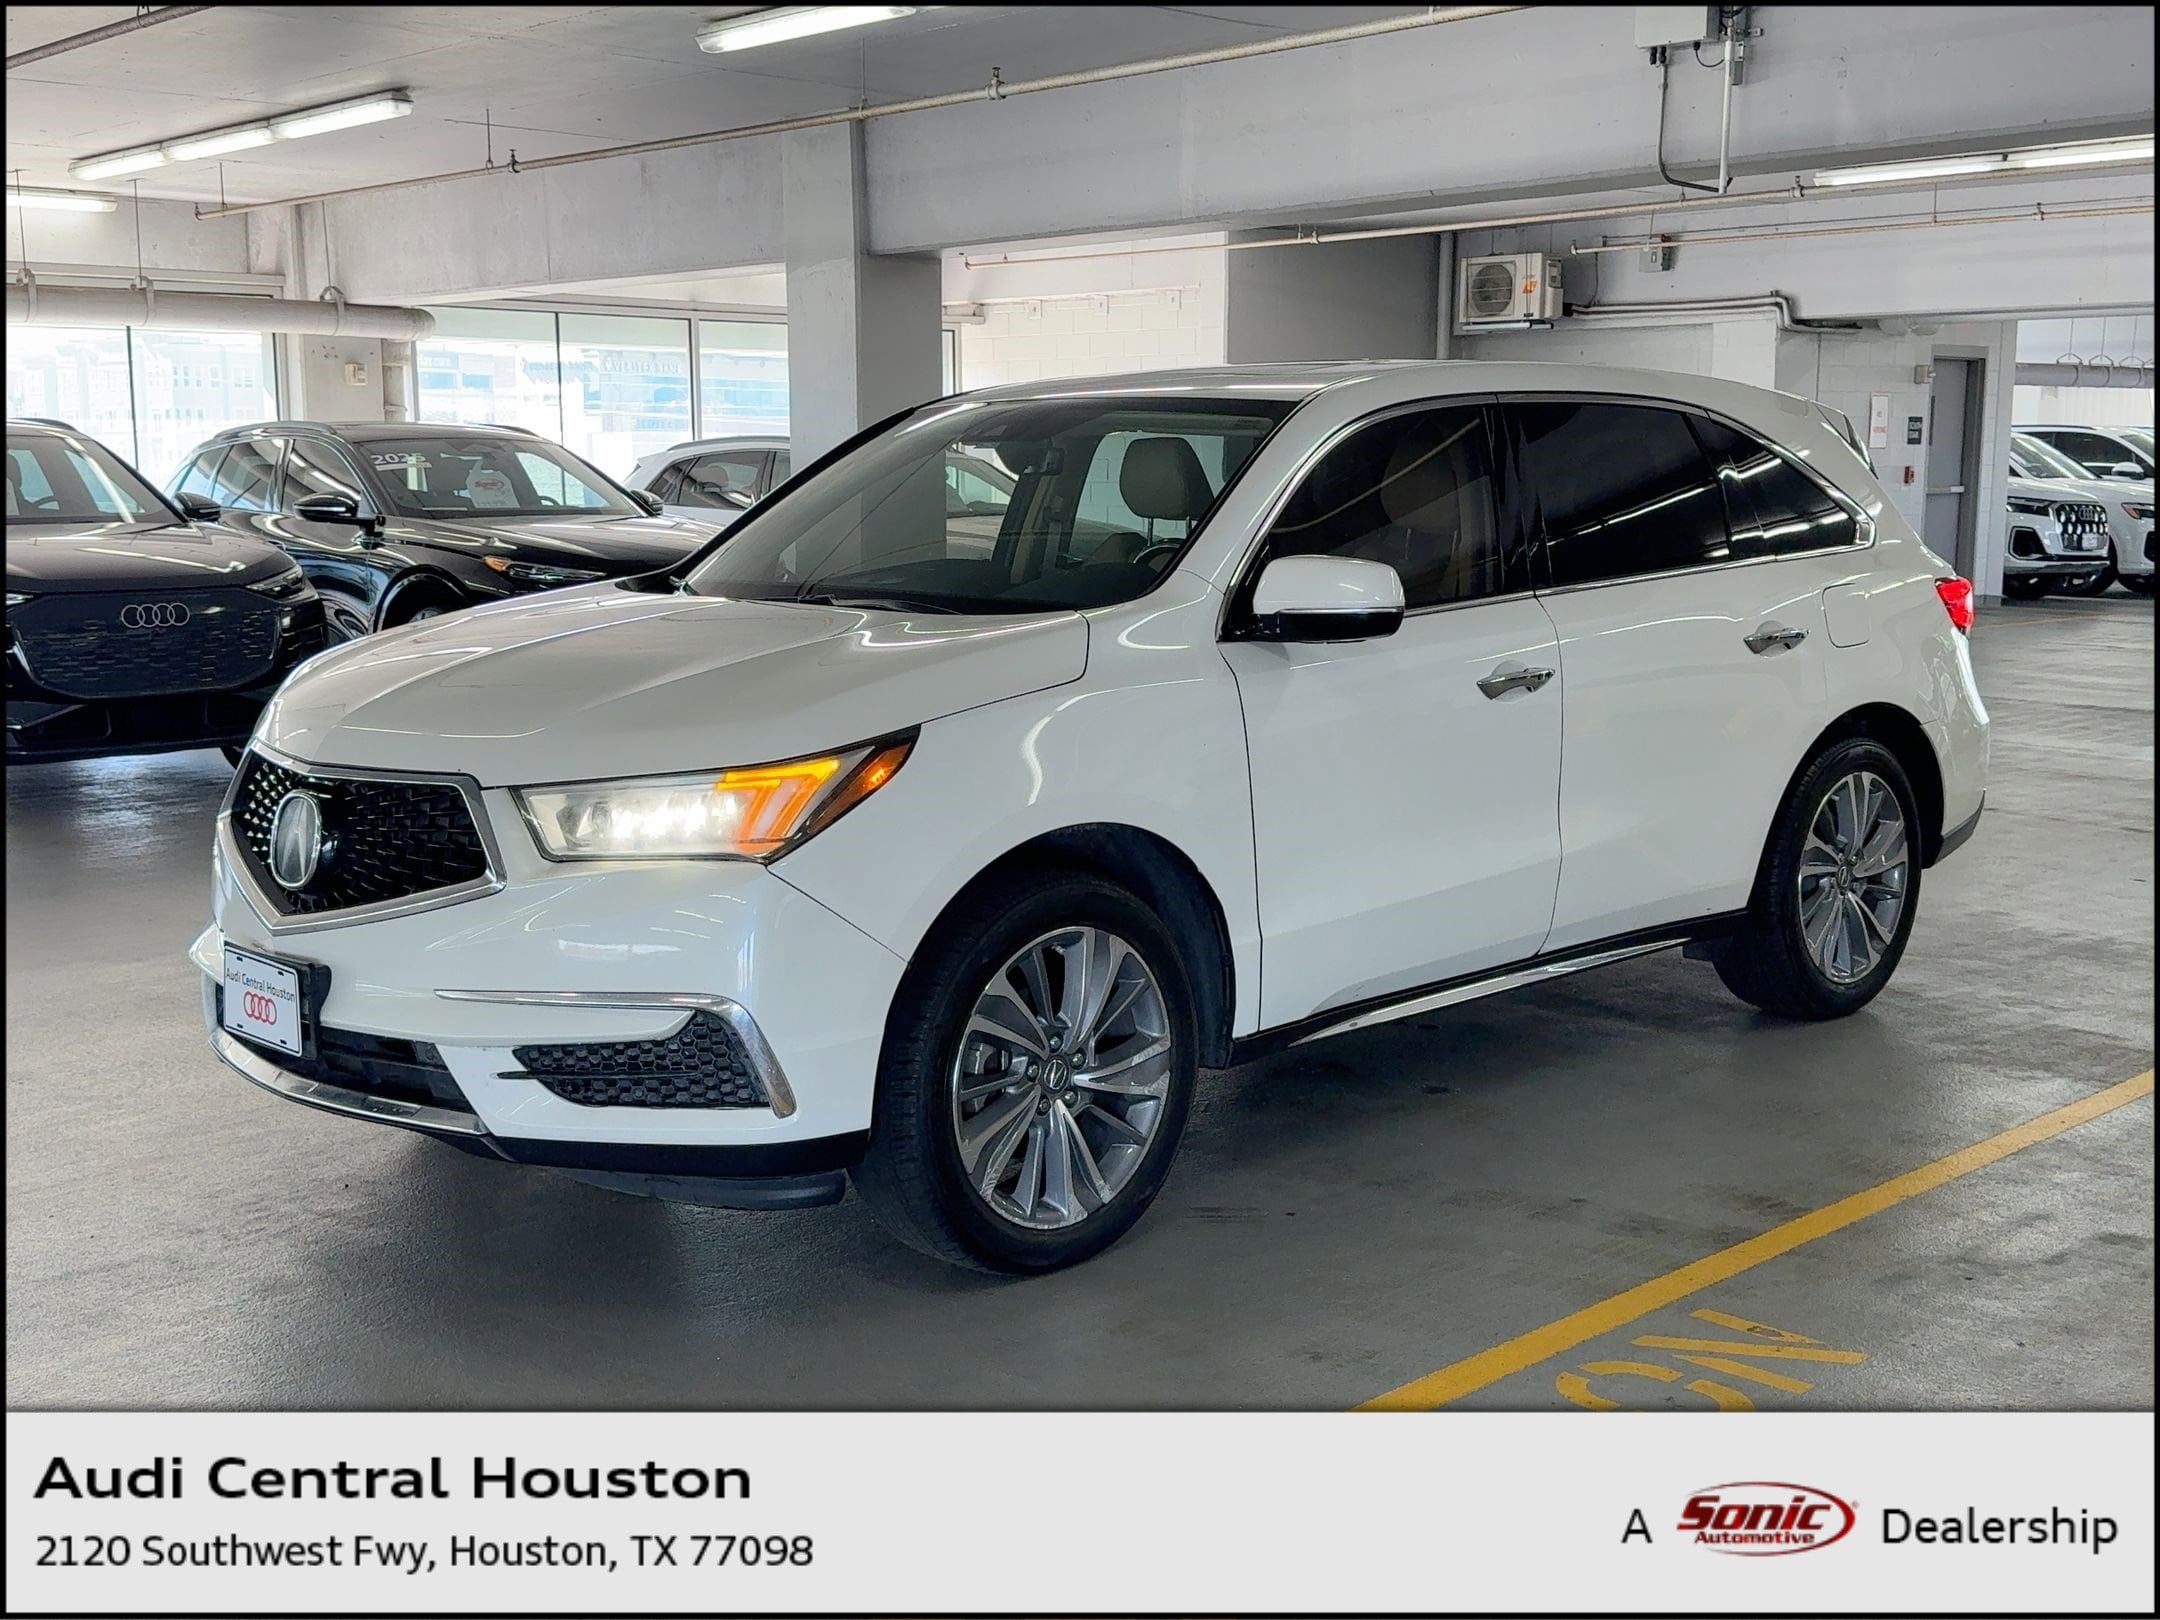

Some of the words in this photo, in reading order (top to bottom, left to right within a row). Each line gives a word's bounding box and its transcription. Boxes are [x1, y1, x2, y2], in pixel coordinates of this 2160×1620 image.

[225, 967, 241, 982] Audi
[241, 973, 265, 992] Central
[266, 981, 294, 1002] Houston
